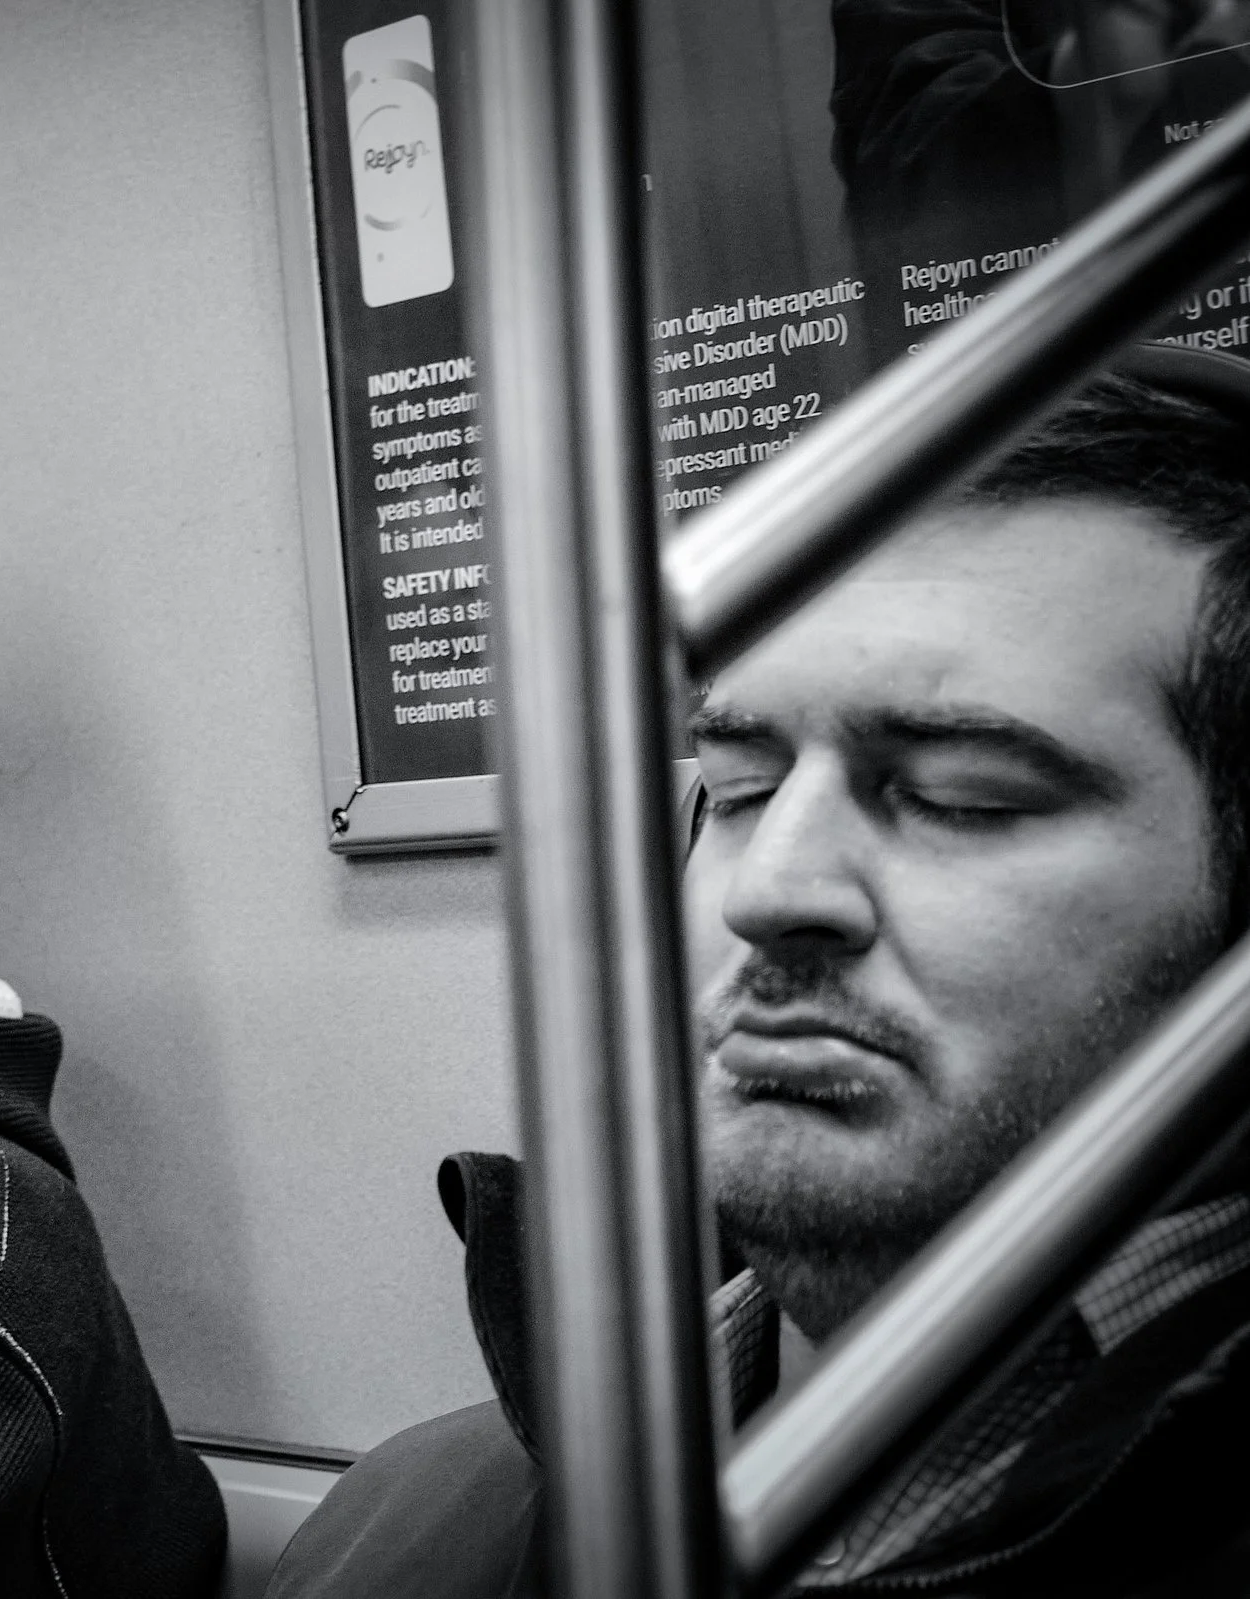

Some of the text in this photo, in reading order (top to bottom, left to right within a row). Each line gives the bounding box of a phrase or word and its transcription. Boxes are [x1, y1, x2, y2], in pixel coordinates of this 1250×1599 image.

[901, 259, 976, 292] Rejoyn
[685, 299, 745, 335] digital
[747, 278, 865, 320] therapeutic
[1207, 286, 1234, 309] or
[693, 332, 776, 367] Disorder
[780, 313, 848, 355] (MDD)
[370, 405, 396, 428] for
[396, 400, 425, 424] the
[700, 406, 749, 436] MDD
[752, 403, 791, 430] age
[793, 393, 822, 420] 22
[372, 428, 461, 465] symptoms
[375, 458, 459, 492] outpatient
[376, 500, 423, 529] years
[425, 488, 457, 515] and
[380, 517, 484, 554] It is intended
[382, 569, 451, 599] SAFETY
[386, 604, 427, 631] used
[429, 605, 450, 625] as
[453, 604, 465, 622] a
[389, 635, 487, 665] replace your
[392, 671, 417, 693] for
[394, 697, 476, 725] treatment
